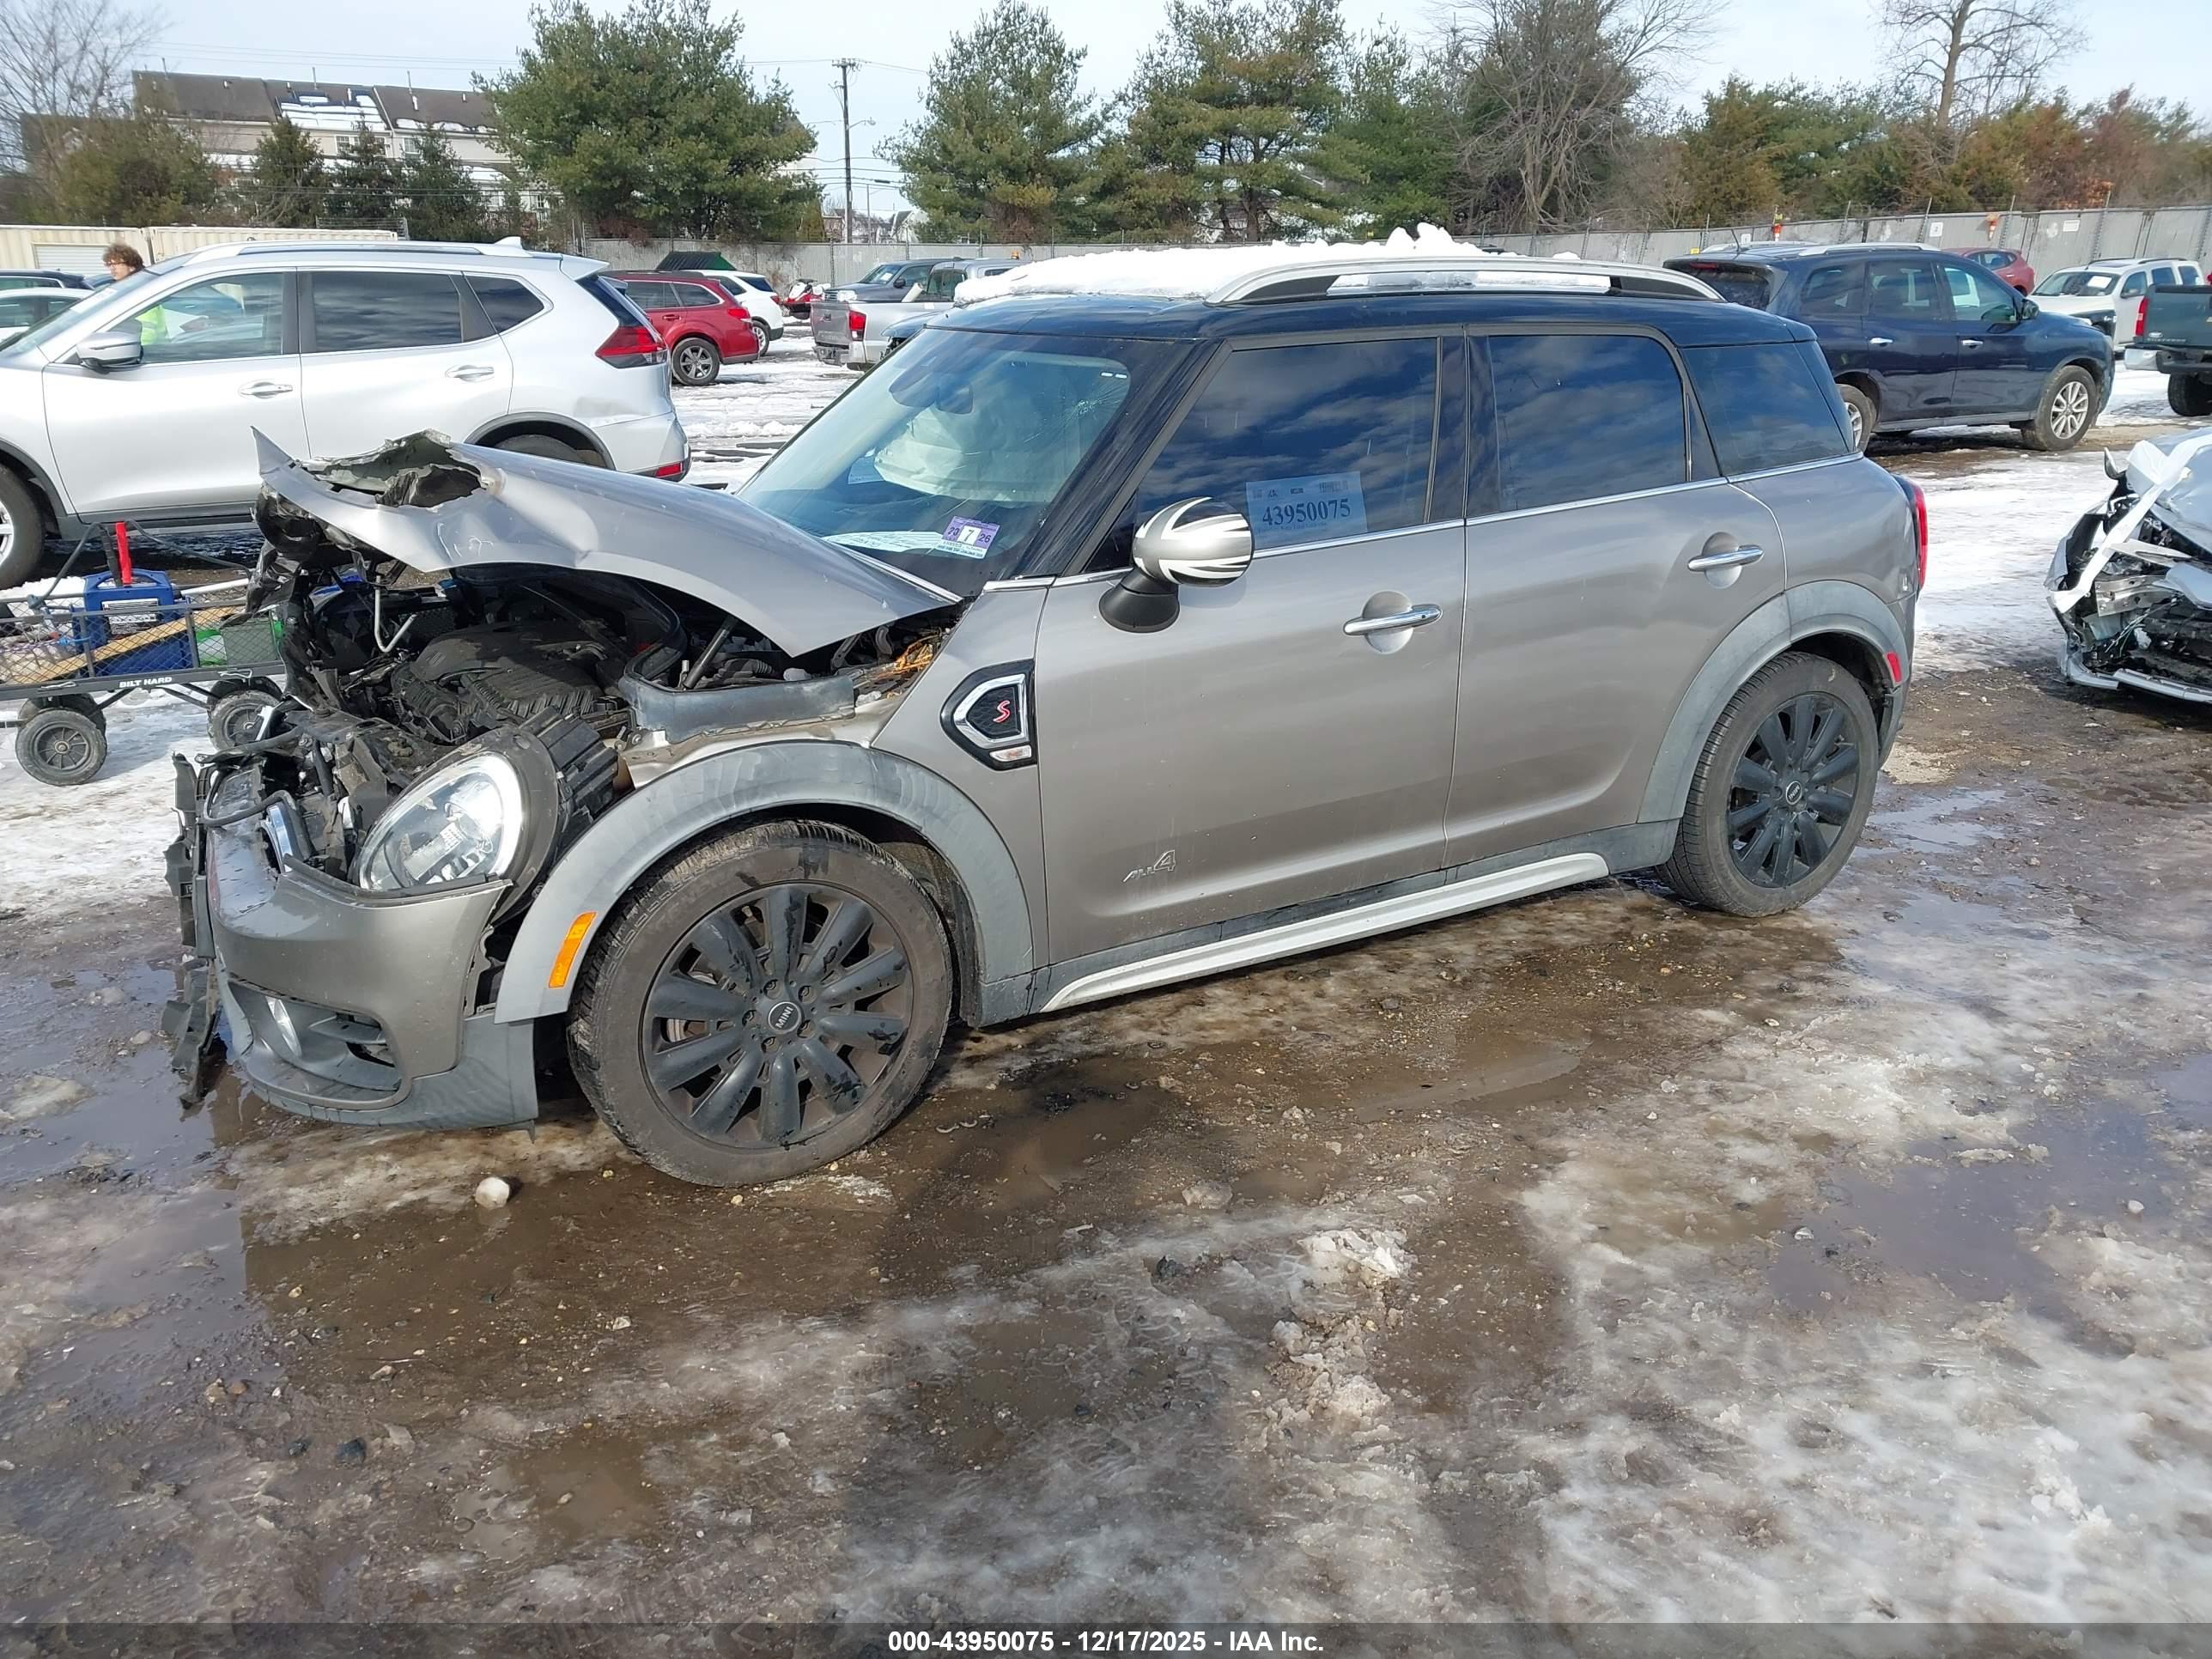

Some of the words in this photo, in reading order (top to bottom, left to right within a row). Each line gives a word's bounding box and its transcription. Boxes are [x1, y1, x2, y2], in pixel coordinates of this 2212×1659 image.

[1262, 498, 1351, 526] 43950075
[947, 526, 960, 537] 20
[963, 529, 975, 542] 7
[979, 533, 992, 544] 26
[143, 677, 173, 685] HARD
[993, 700, 1011, 723] S
[1788, 784, 1801, 800] MINI
[775, 1006, 793, 1029] MINI
